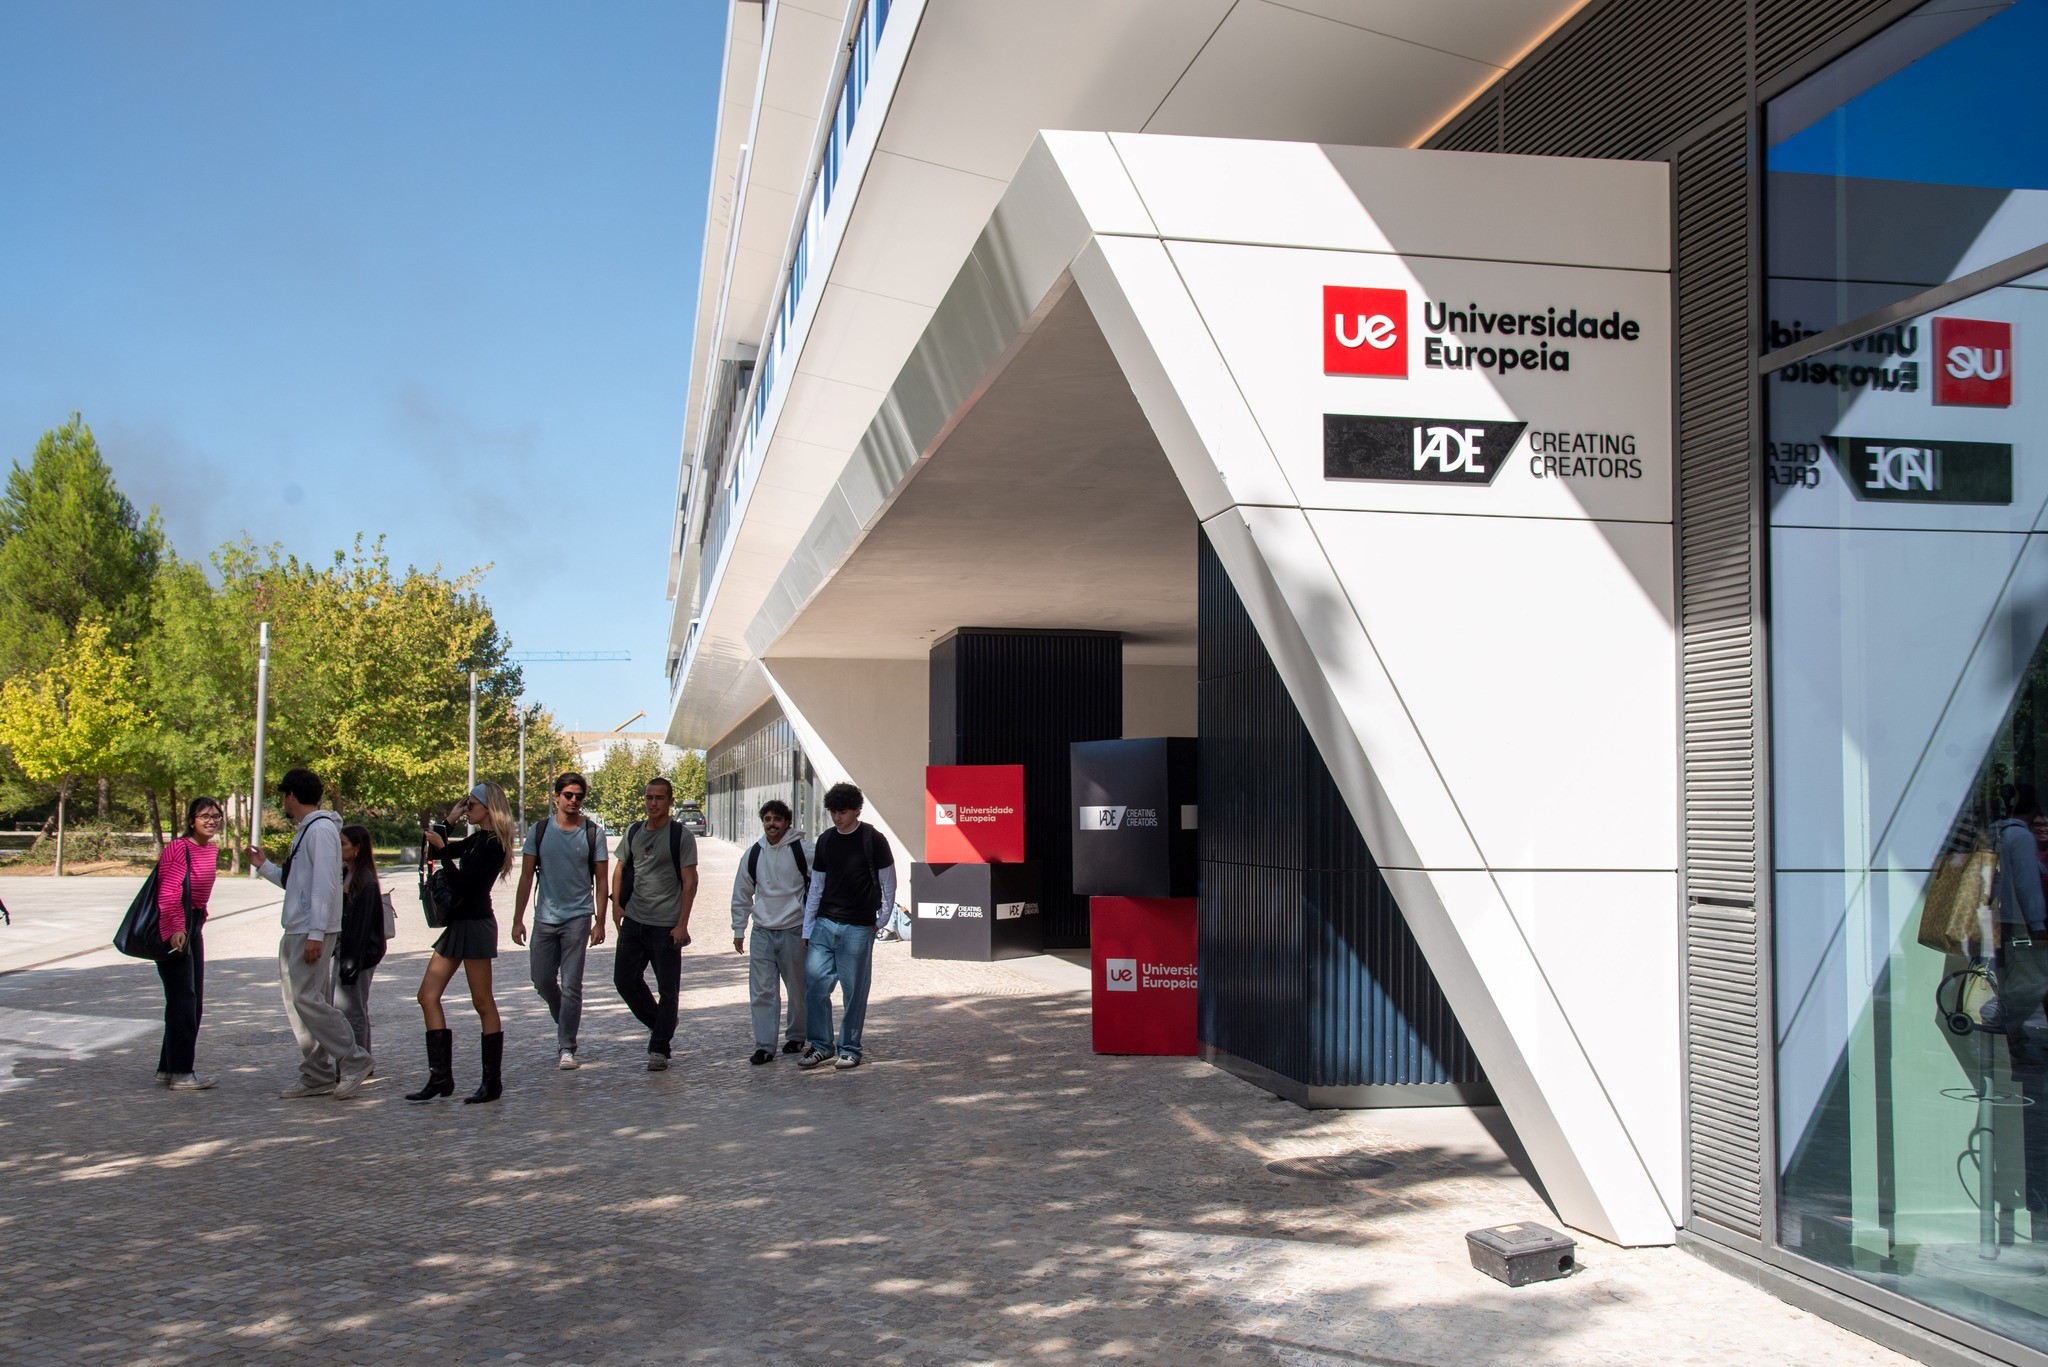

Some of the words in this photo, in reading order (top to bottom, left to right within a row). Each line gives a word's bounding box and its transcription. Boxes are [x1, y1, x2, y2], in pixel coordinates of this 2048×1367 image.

[1425, 301, 1640, 341] Universidade
[1335, 313, 1397, 350] ue
[1425, 337, 1570, 375] Europeia
[1530, 431, 1635, 455] CREATING
[1530, 456, 1642, 479] CREATORS
[960, 806, 1014, 814] Universidade
[1126, 808, 1156, 818] CREATING
[960, 814, 996, 823] Europeia
[1126, 818, 1158, 827] CREATORS
[1110, 968, 1133, 982] ue
[1142, 976, 1198, 990] Europeia
